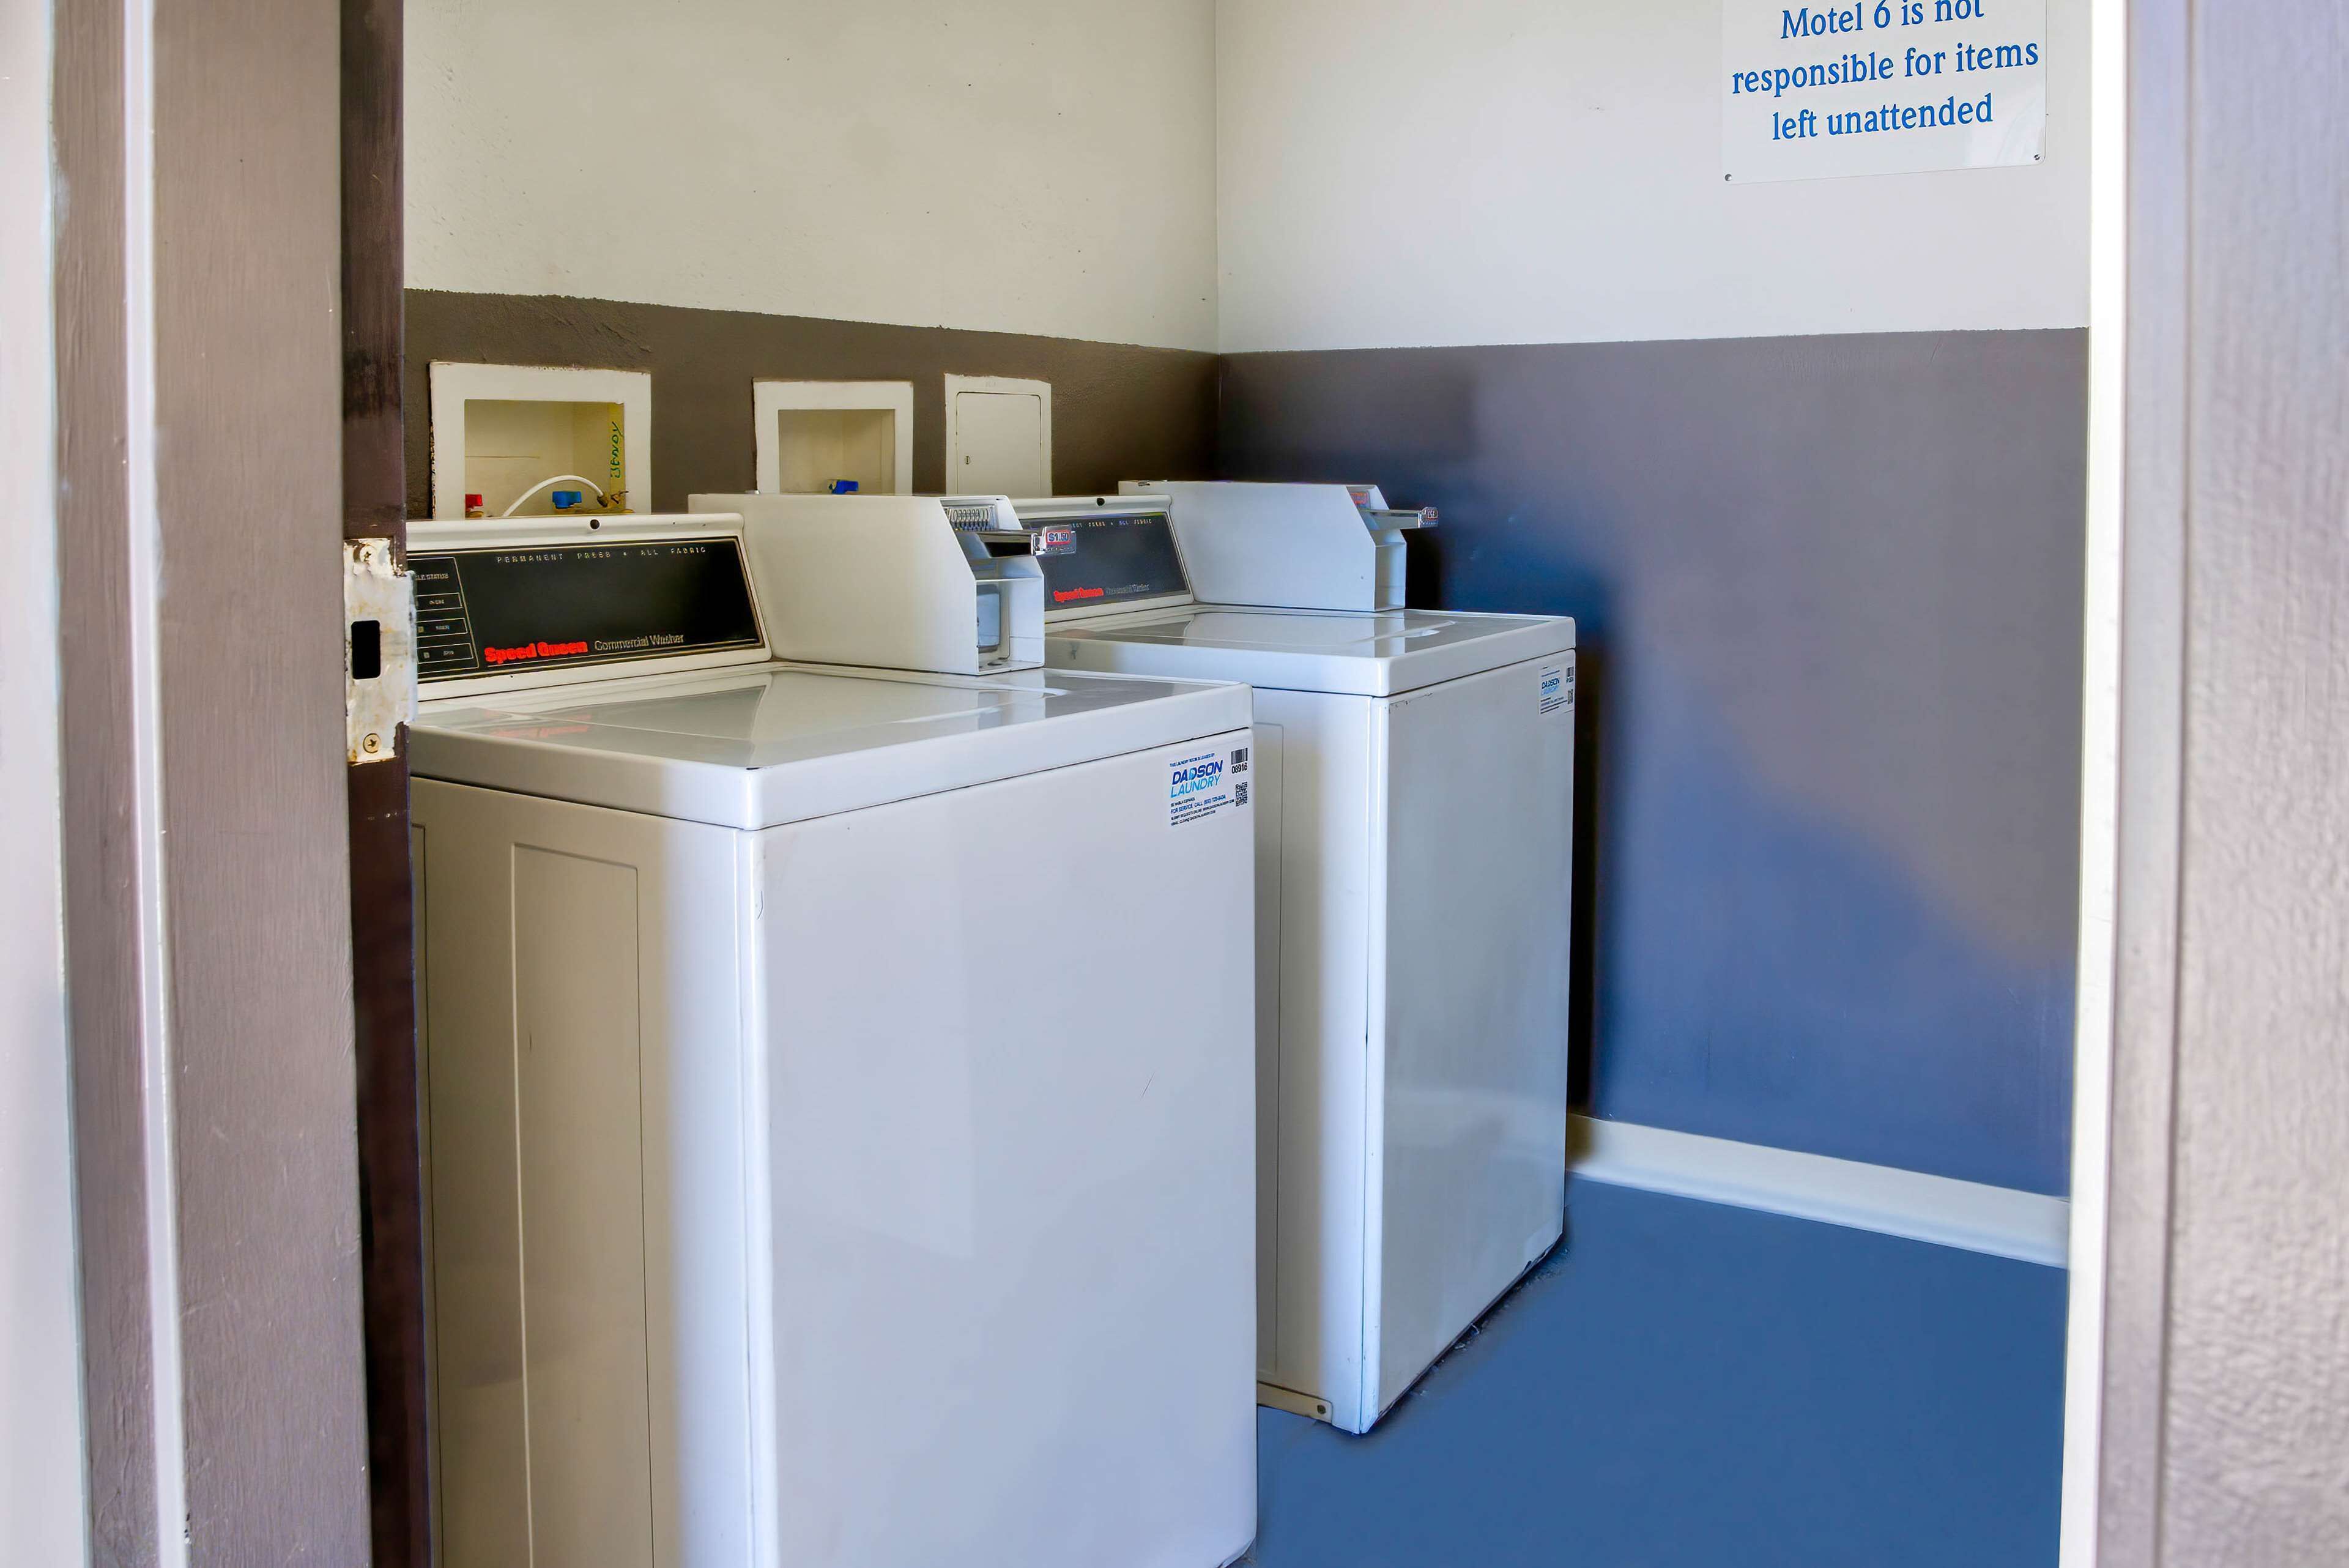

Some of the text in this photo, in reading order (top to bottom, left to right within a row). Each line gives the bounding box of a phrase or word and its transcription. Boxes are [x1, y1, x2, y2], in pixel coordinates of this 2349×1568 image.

[1781, 1, 1863, 39] Motel
[1874, 0, 1891, 28] 6
[1901, 0, 1924, 26] is
[1732, 42, 2039, 97] responsible for items
[1772, 93, 1994, 140] left unattended
[497, 554, 563, 563] PERMANENT
[484, 633, 685, 664] Speed Queen Commercial Washer
[1171, 774, 1221, 798] LAUNDRY
[1172, 760, 1223, 785] DADSON
